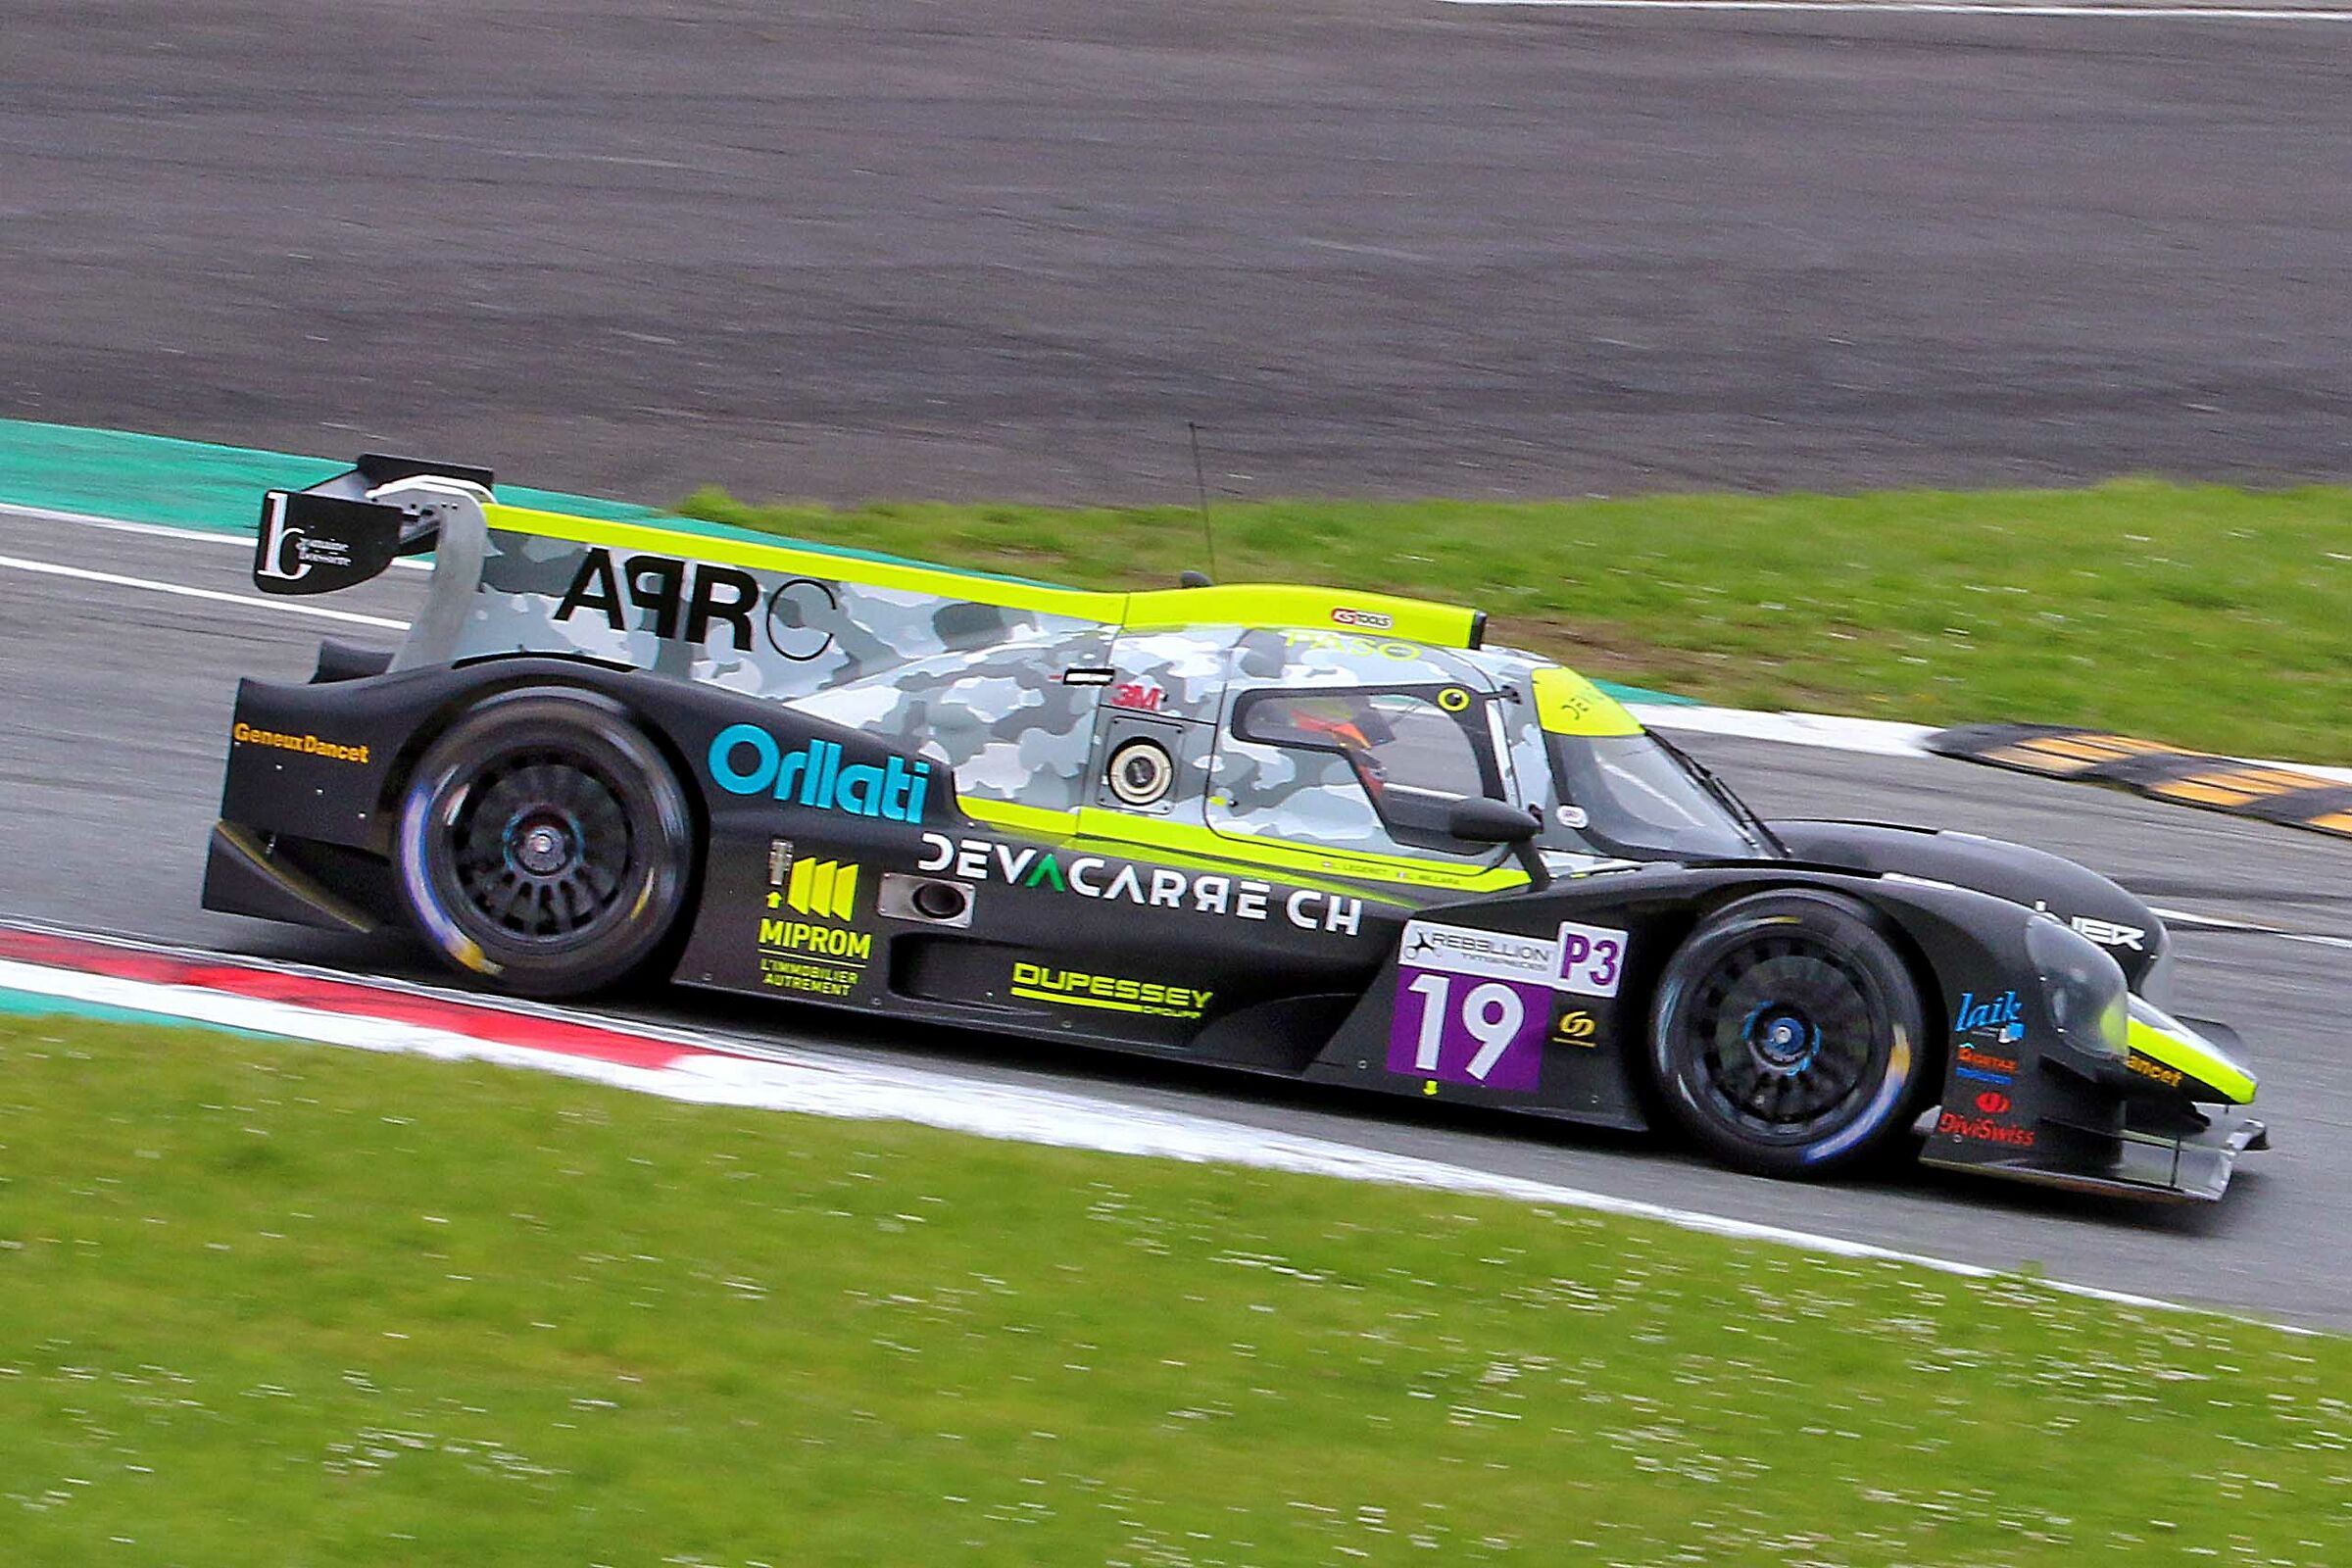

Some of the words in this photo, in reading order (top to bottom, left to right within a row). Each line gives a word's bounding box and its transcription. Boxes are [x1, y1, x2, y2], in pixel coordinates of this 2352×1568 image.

[1111, 683, 1163, 711] 3M
[709, 723, 931, 824] Orllati
[759, 917, 872, 959] MIPROM
[1432, 932, 1549, 962] REBELLION
[1560, 933, 1619, 986] P3
[762, 972, 852, 997] AUTREMENT
[1012, 962, 1214, 1008] DUPESSEY
[1408, 973, 1526, 1081] 19
